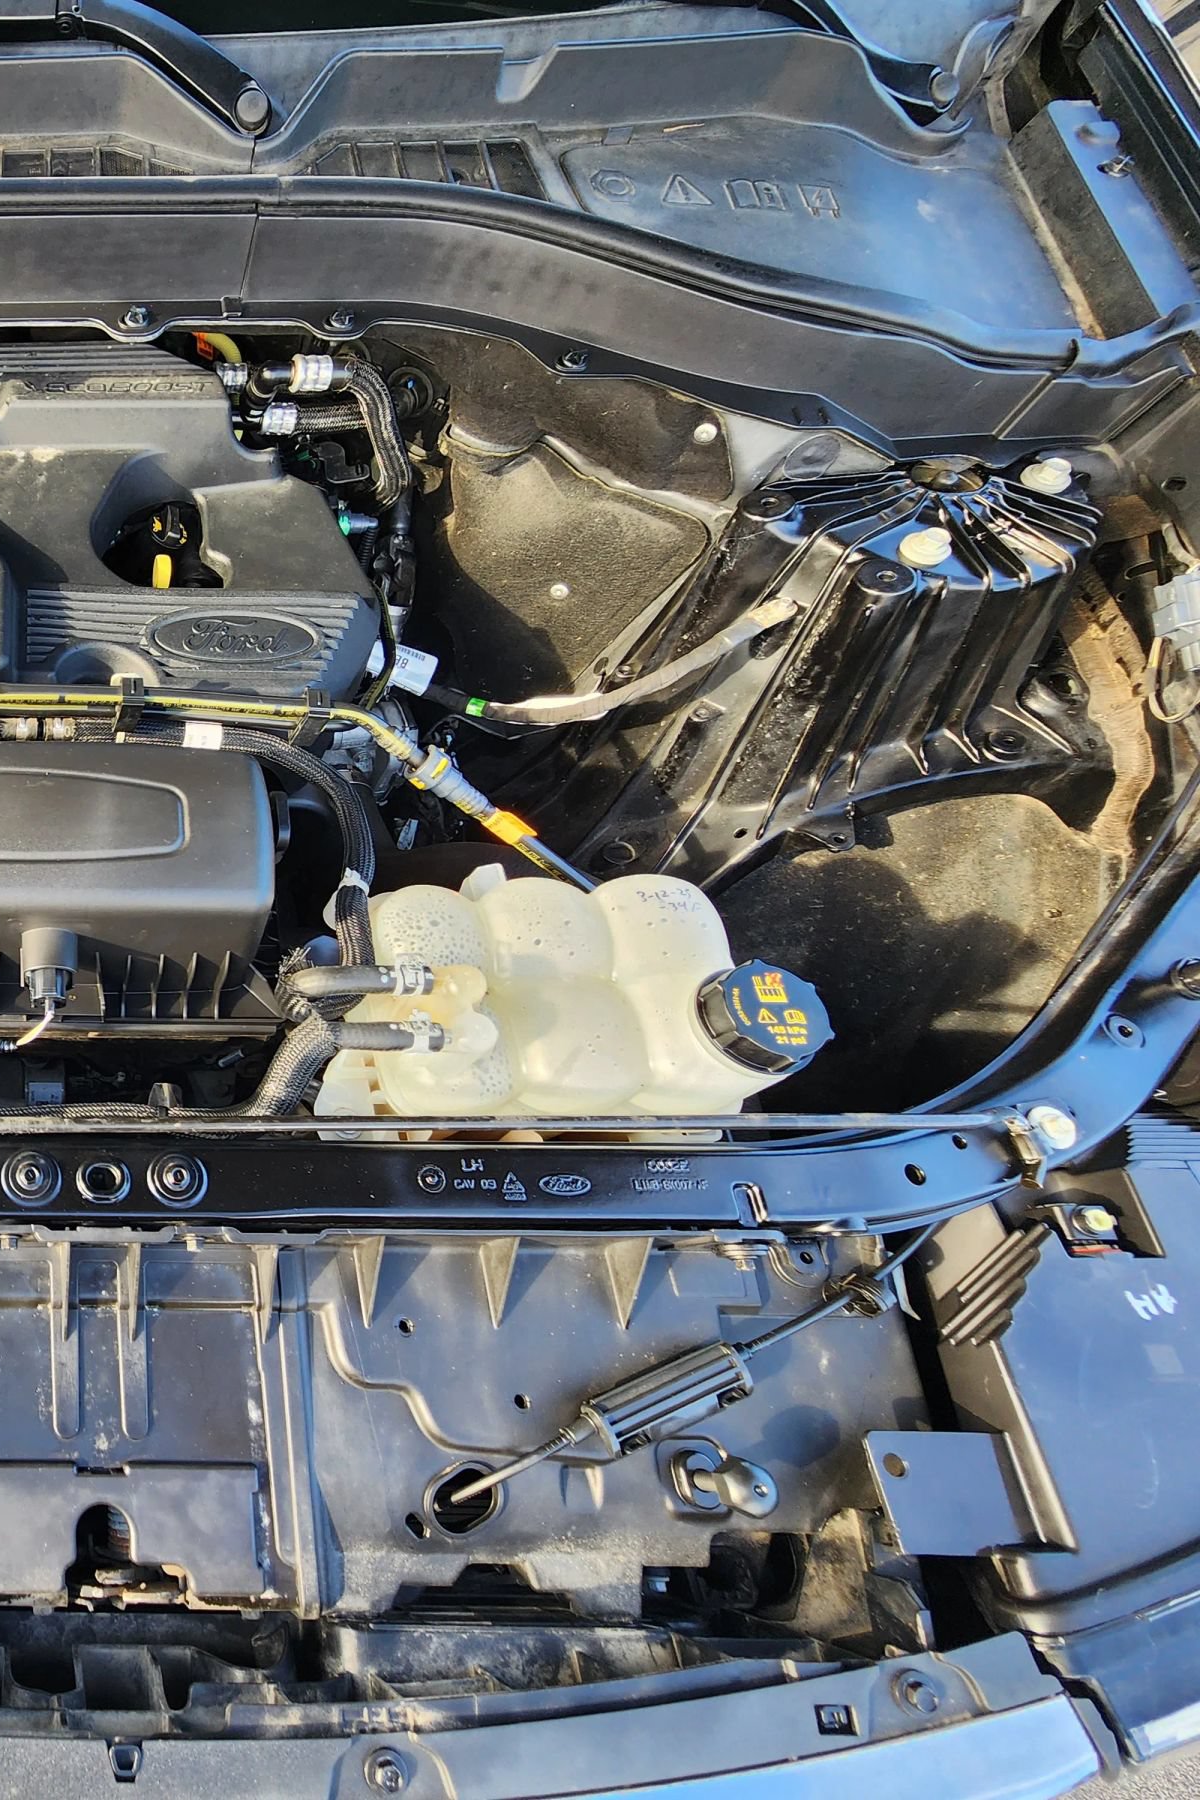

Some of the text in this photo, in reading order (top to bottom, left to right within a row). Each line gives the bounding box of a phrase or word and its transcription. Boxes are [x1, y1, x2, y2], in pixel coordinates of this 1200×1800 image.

[182, 618, 289, 654] Ford
[786, 1025, 808, 1035] kPa
[775, 1035, 808, 1046] 21 psi
[460, 1158, 484, 1171] LH
[453, 1179, 475, 1190] CAV
